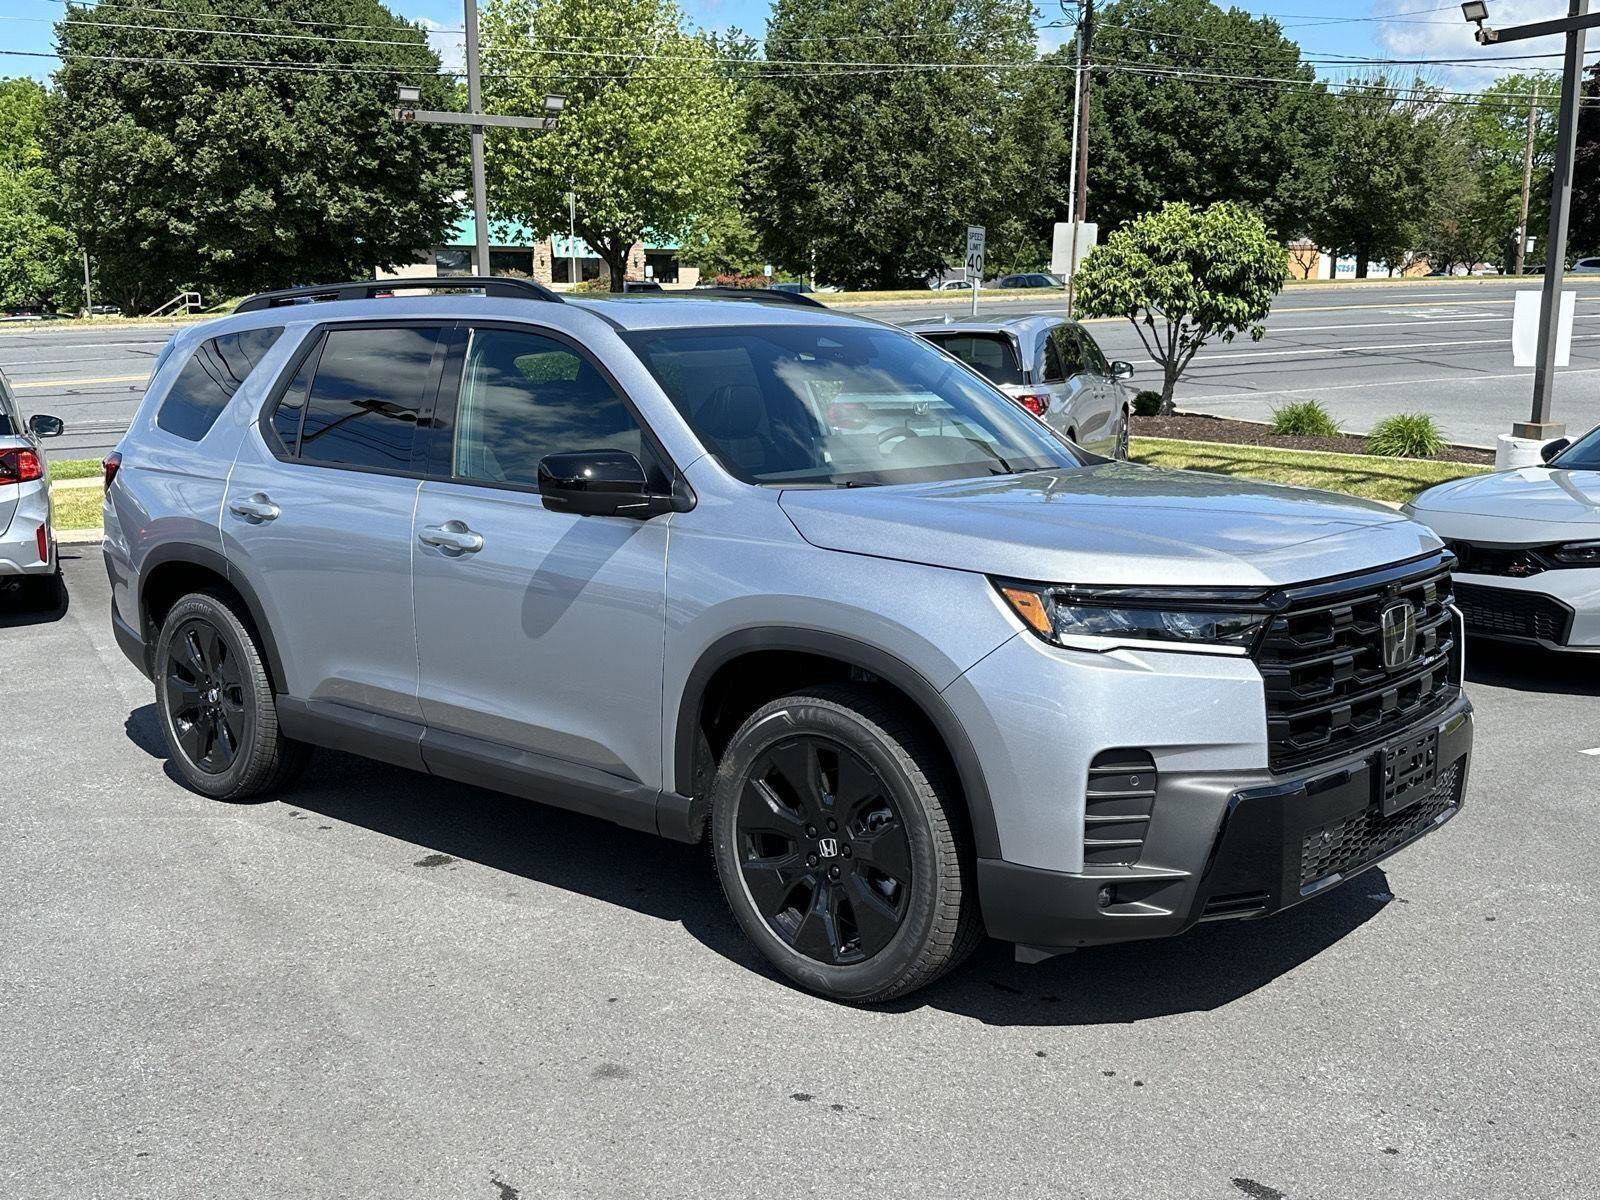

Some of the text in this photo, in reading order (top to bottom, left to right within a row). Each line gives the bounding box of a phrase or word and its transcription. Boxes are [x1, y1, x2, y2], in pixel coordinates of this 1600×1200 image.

[968, 232, 984, 241] SPEED
[969, 243, 982, 251] LIMIT
[968, 253, 982, 272] 40
